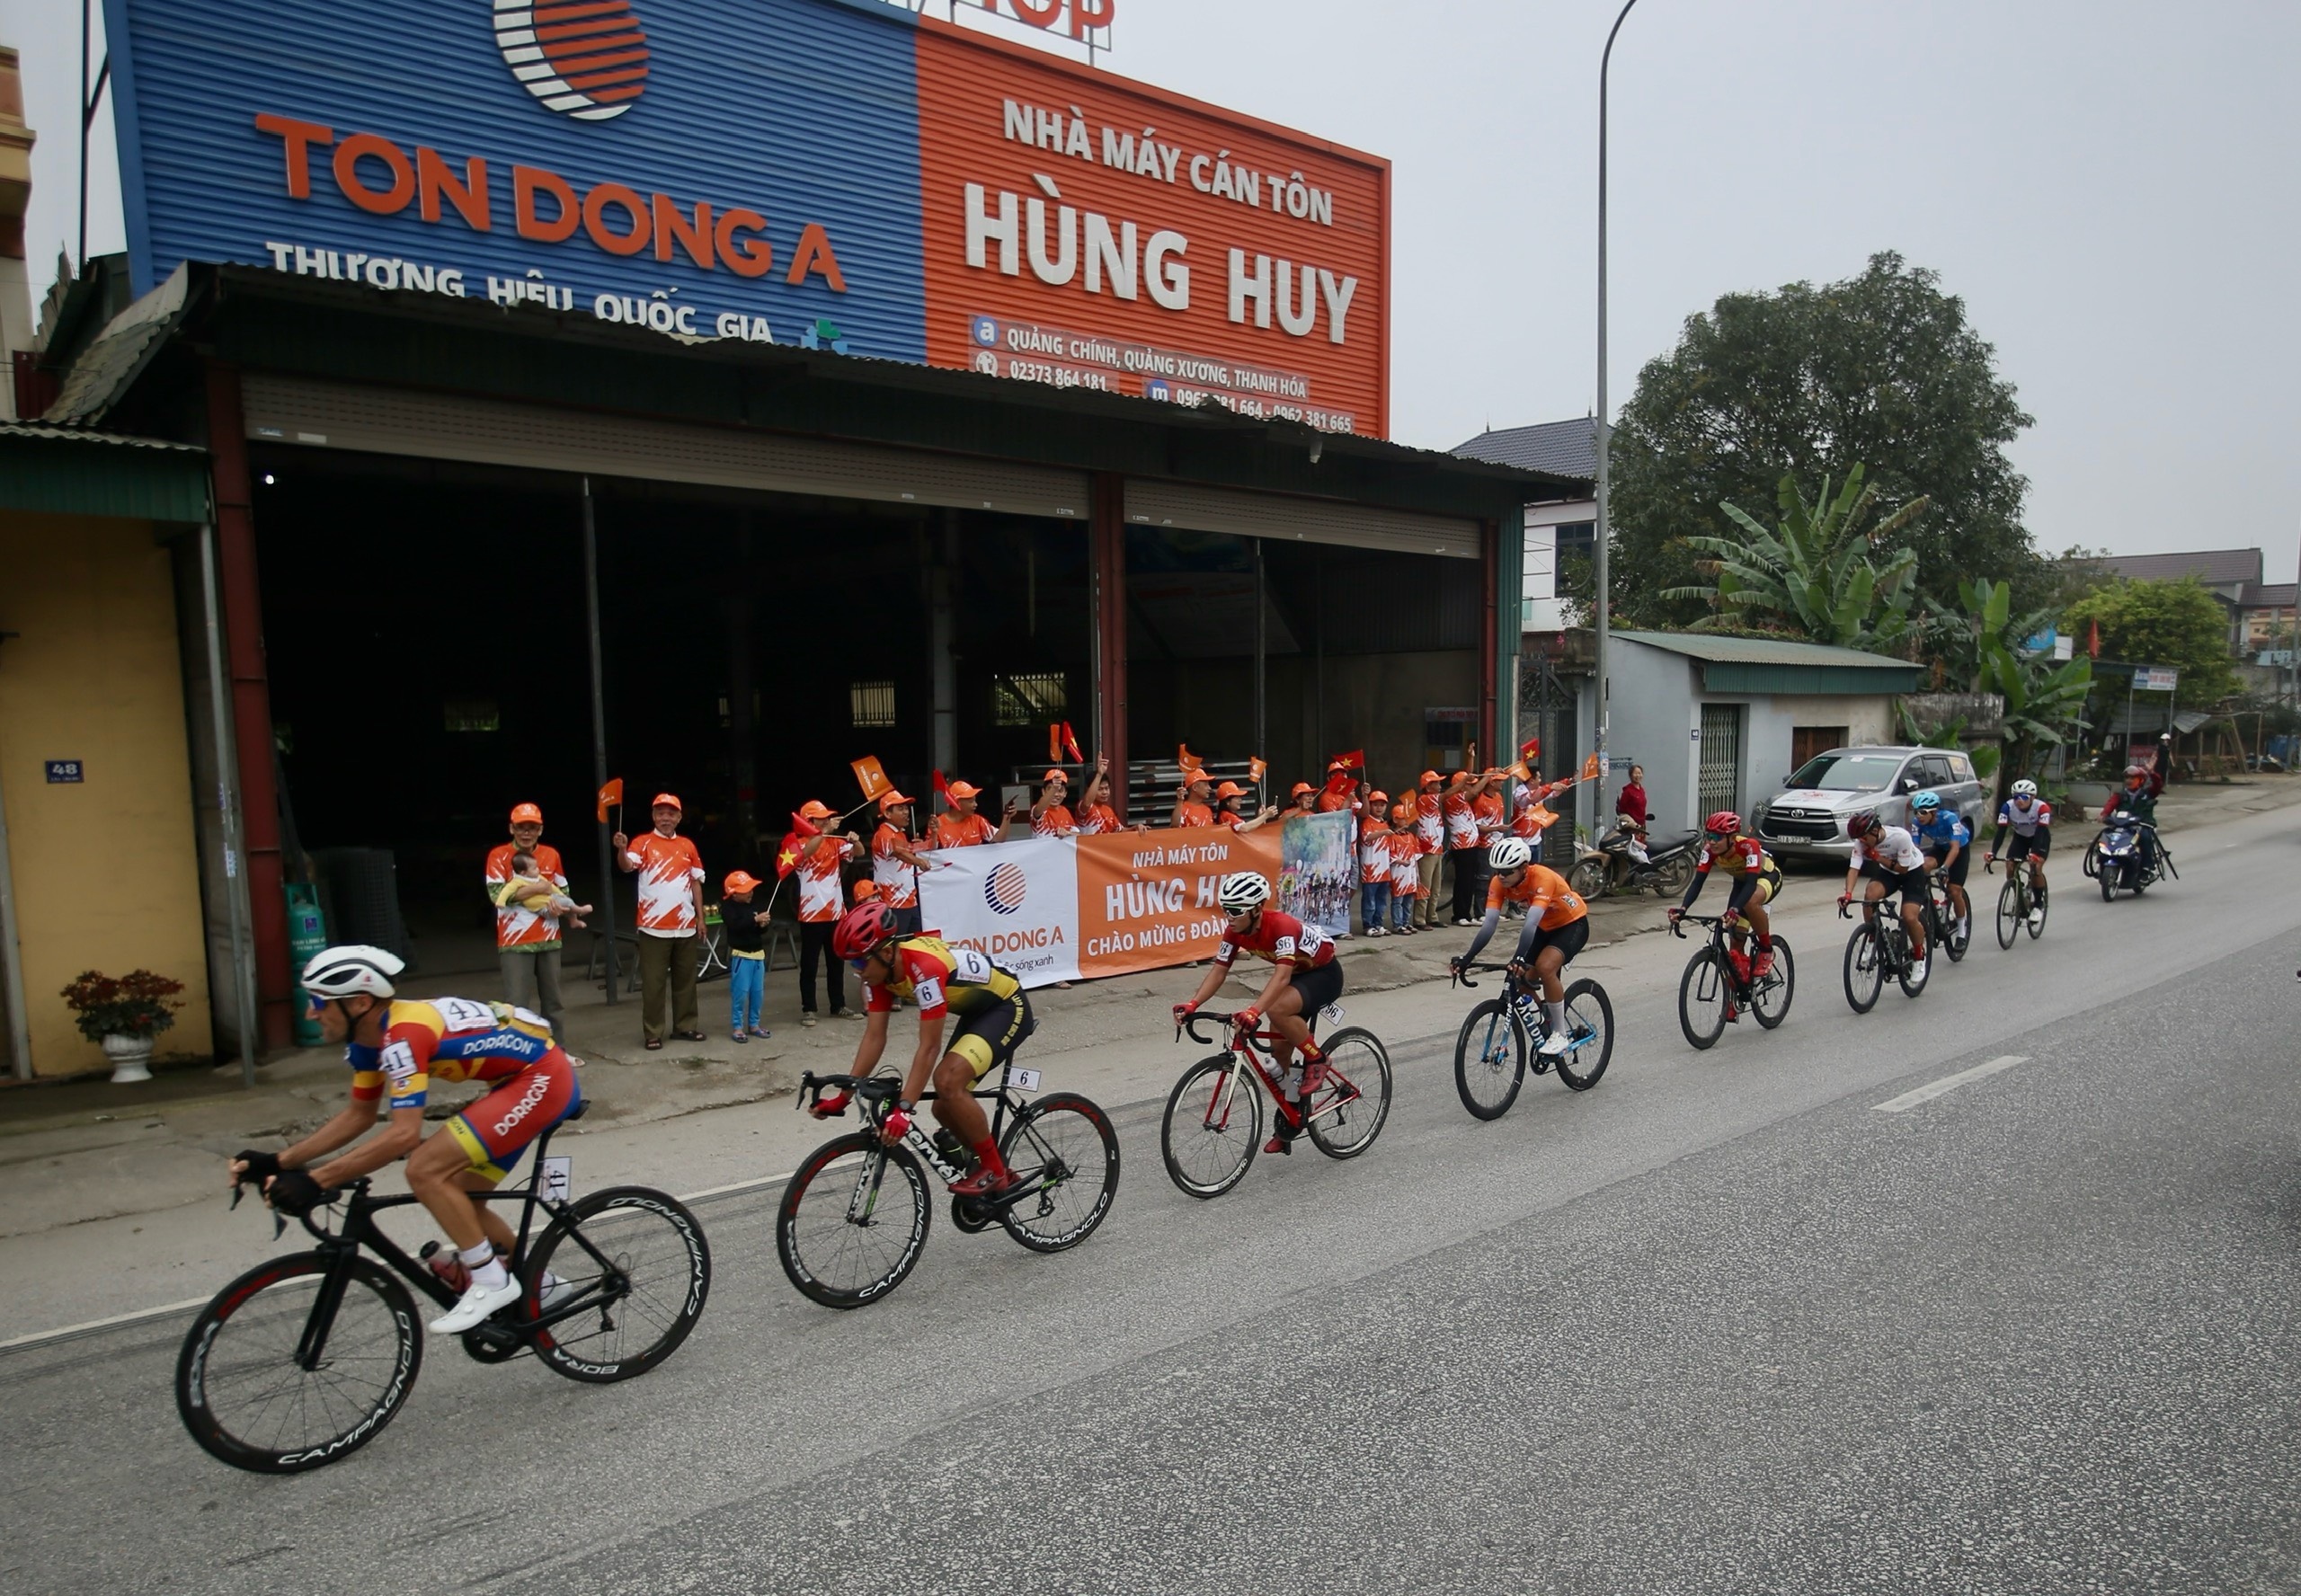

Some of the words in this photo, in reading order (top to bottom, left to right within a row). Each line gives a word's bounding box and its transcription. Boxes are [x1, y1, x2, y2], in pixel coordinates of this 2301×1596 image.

[1003, 98, 1093, 162] NHÀ
[1102, 128, 1180, 183] MÁY
[1189, 150, 1259, 207] CÁN
[1266, 172, 1332, 227] TÔN
[255, 114, 491, 232] TON
[513, 165, 772, 278] DONG
[786, 222, 847, 293] A
[964, 173, 1190, 312] HÙNG
[1228, 248, 1357, 345] HUY
[716, 313, 774, 344] GIA
[1007, 326, 1063, 355] QUẢNG
[1070, 339, 1121, 368] CHÍNH,
[1124, 347, 1174, 375] QUẢNG
[1177, 359, 1230, 387] XƯƠNG,
[1235, 369, 1277, 394] THANH
[1280, 377, 1306, 398] HÓA
[1010, 360, 1052, 384] 02373
[1055, 368, 1079, 388] 864
[1083, 373, 1106, 392] 181
[1239, 399, 1263, 418] 664
[1306, 410, 1327, 429] 381
[1330, 415, 1351, 432] 665
[53, 764, 78, 775] 48
[1133, 846, 1164, 868] NHÀ
[1168, 844, 1197, 865] MÁY
[1199, 841, 1228, 863] TÔN
[1106, 873, 1186, 922] HÙNG
[992, 927, 1047, 954] DONG
[1050, 926, 1064, 945] A
[1087, 930, 1134, 956] CHÀO
[1140, 924, 1186, 948] MỪNG
[1190, 915, 1230, 940] ĐOÀN
[1278, 937, 1292, 950] 96
[1303, 929, 1319, 951] 96
[966, 953, 981, 974] 6
[1035, 953, 1054, 968] xanh
[921, 986, 932, 1002] 6
[449, 1001, 489, 1021] 41
[1326, 1005, 1339, 1018] 96
[1515, 997, 1545, 1046] FACTOR
[462, 1033, 533, 1056] DORAGON
[1020, 1071, 1029, 1086] 6
[493, 1074, 552, 1136] DORAGON
[549, 1170, 567, 1188] 41
[858, 1166, 925, 1298] CAMPAGNOLO
[1008, 1192, 1108, 1244] CAMPAGNOLO
[607, 1197, 704, 1316] CAMPAGNOLO
[553, 1349, 619, 1374] BORA
[278, 1310, 413, 1464] CAMPAGNOLO
